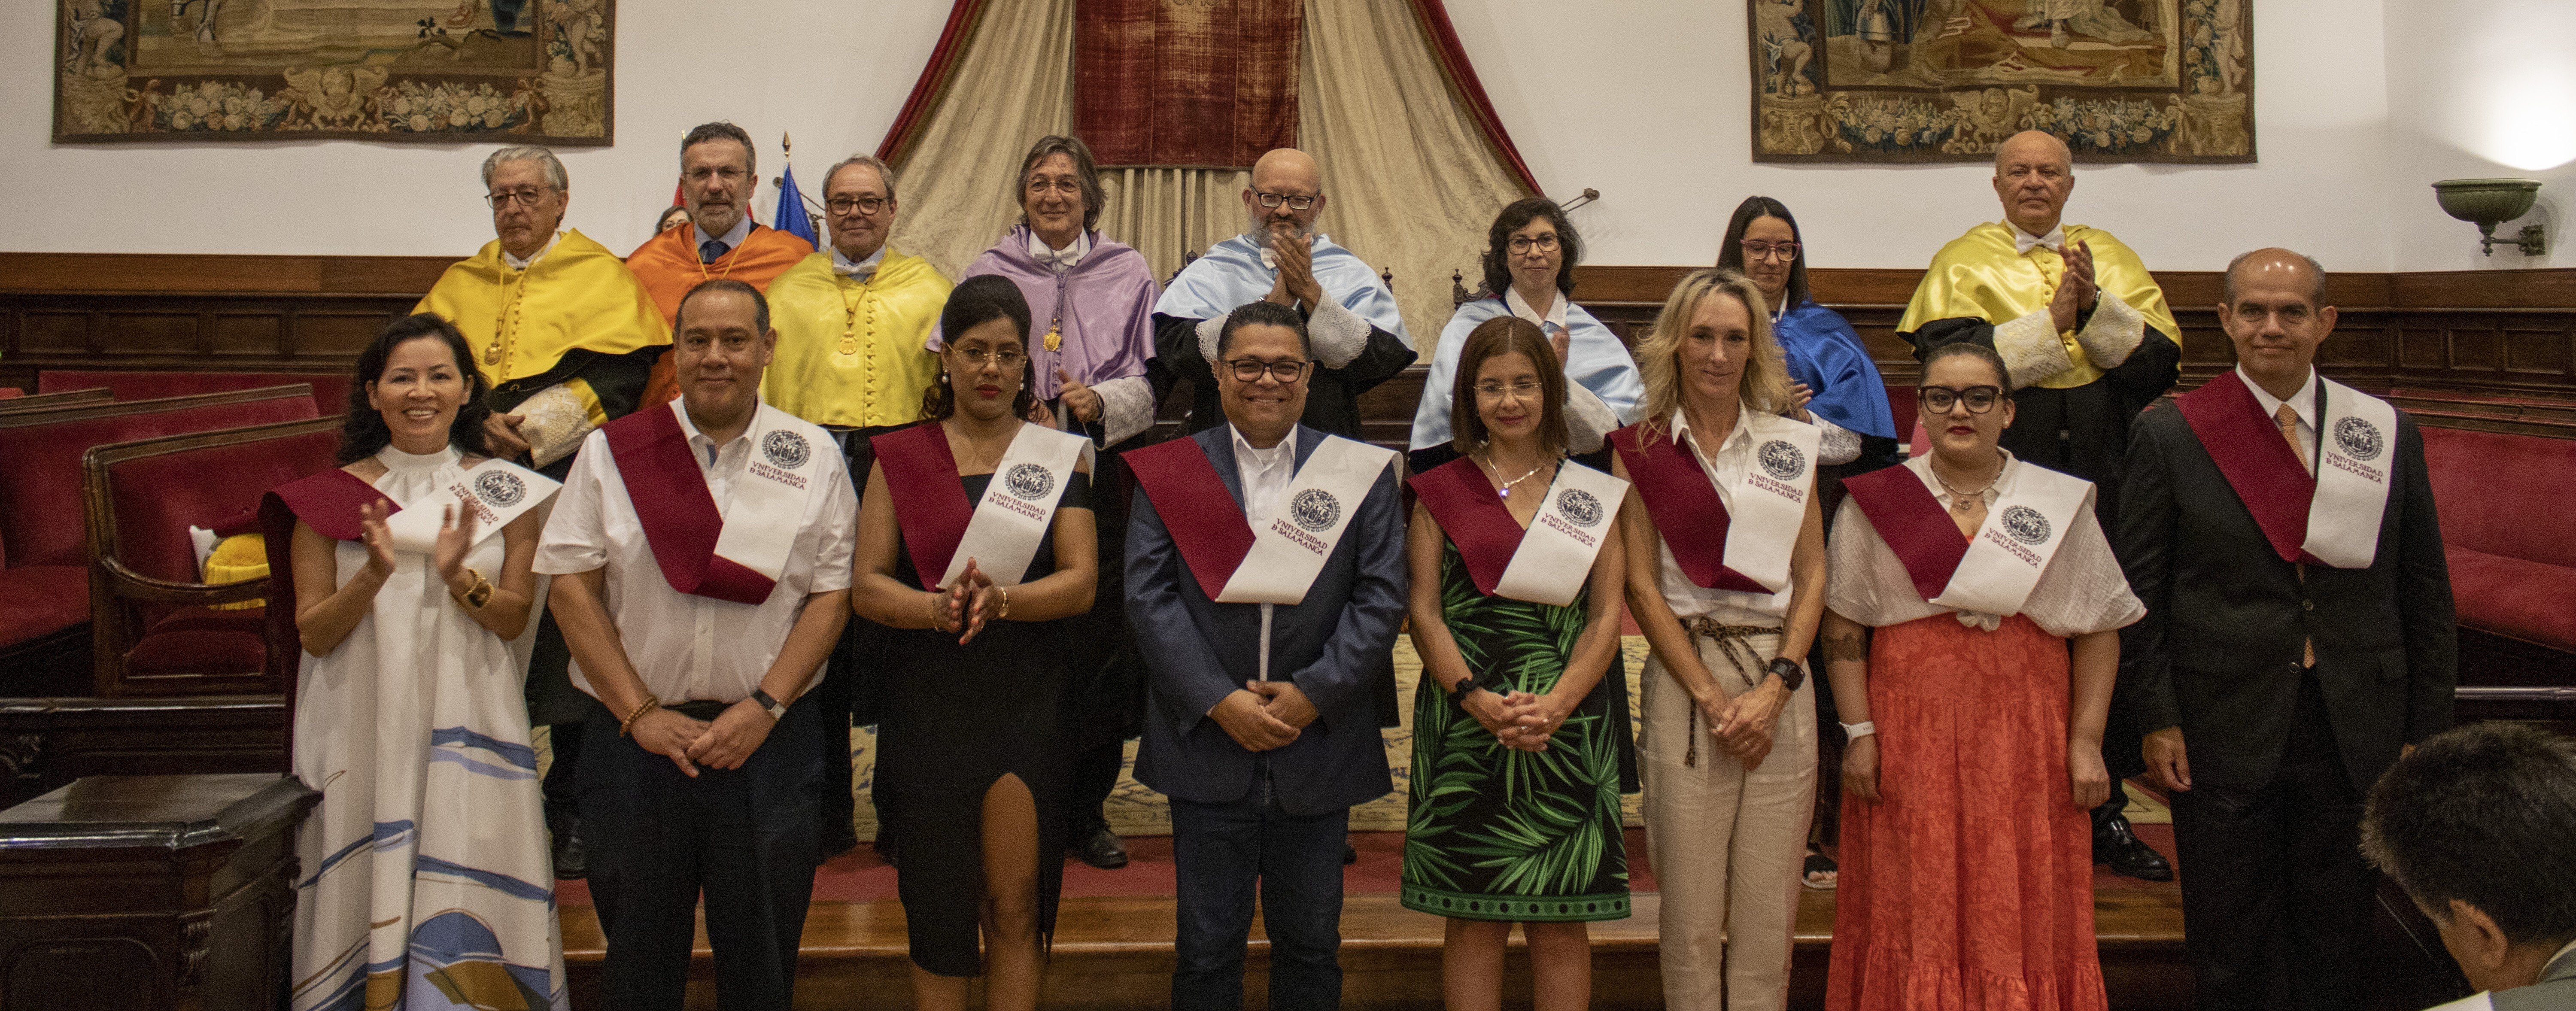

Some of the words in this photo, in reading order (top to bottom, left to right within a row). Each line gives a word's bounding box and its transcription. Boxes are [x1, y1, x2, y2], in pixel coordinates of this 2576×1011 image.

[756, 470, 804, 490] SALAMANCA
[2333, 461, 2382, 484] SALAMANCA
[1755, 481, 1801, 503] SALAMANCA
[995, 500, 1042, 522] SALAMANCA
[1278, 528, 1323, 556] SALAMANCA
[1547, 521, 1592, 548] SALAMANCA
[1992, 537, 2038, 568] SALAMANCA
